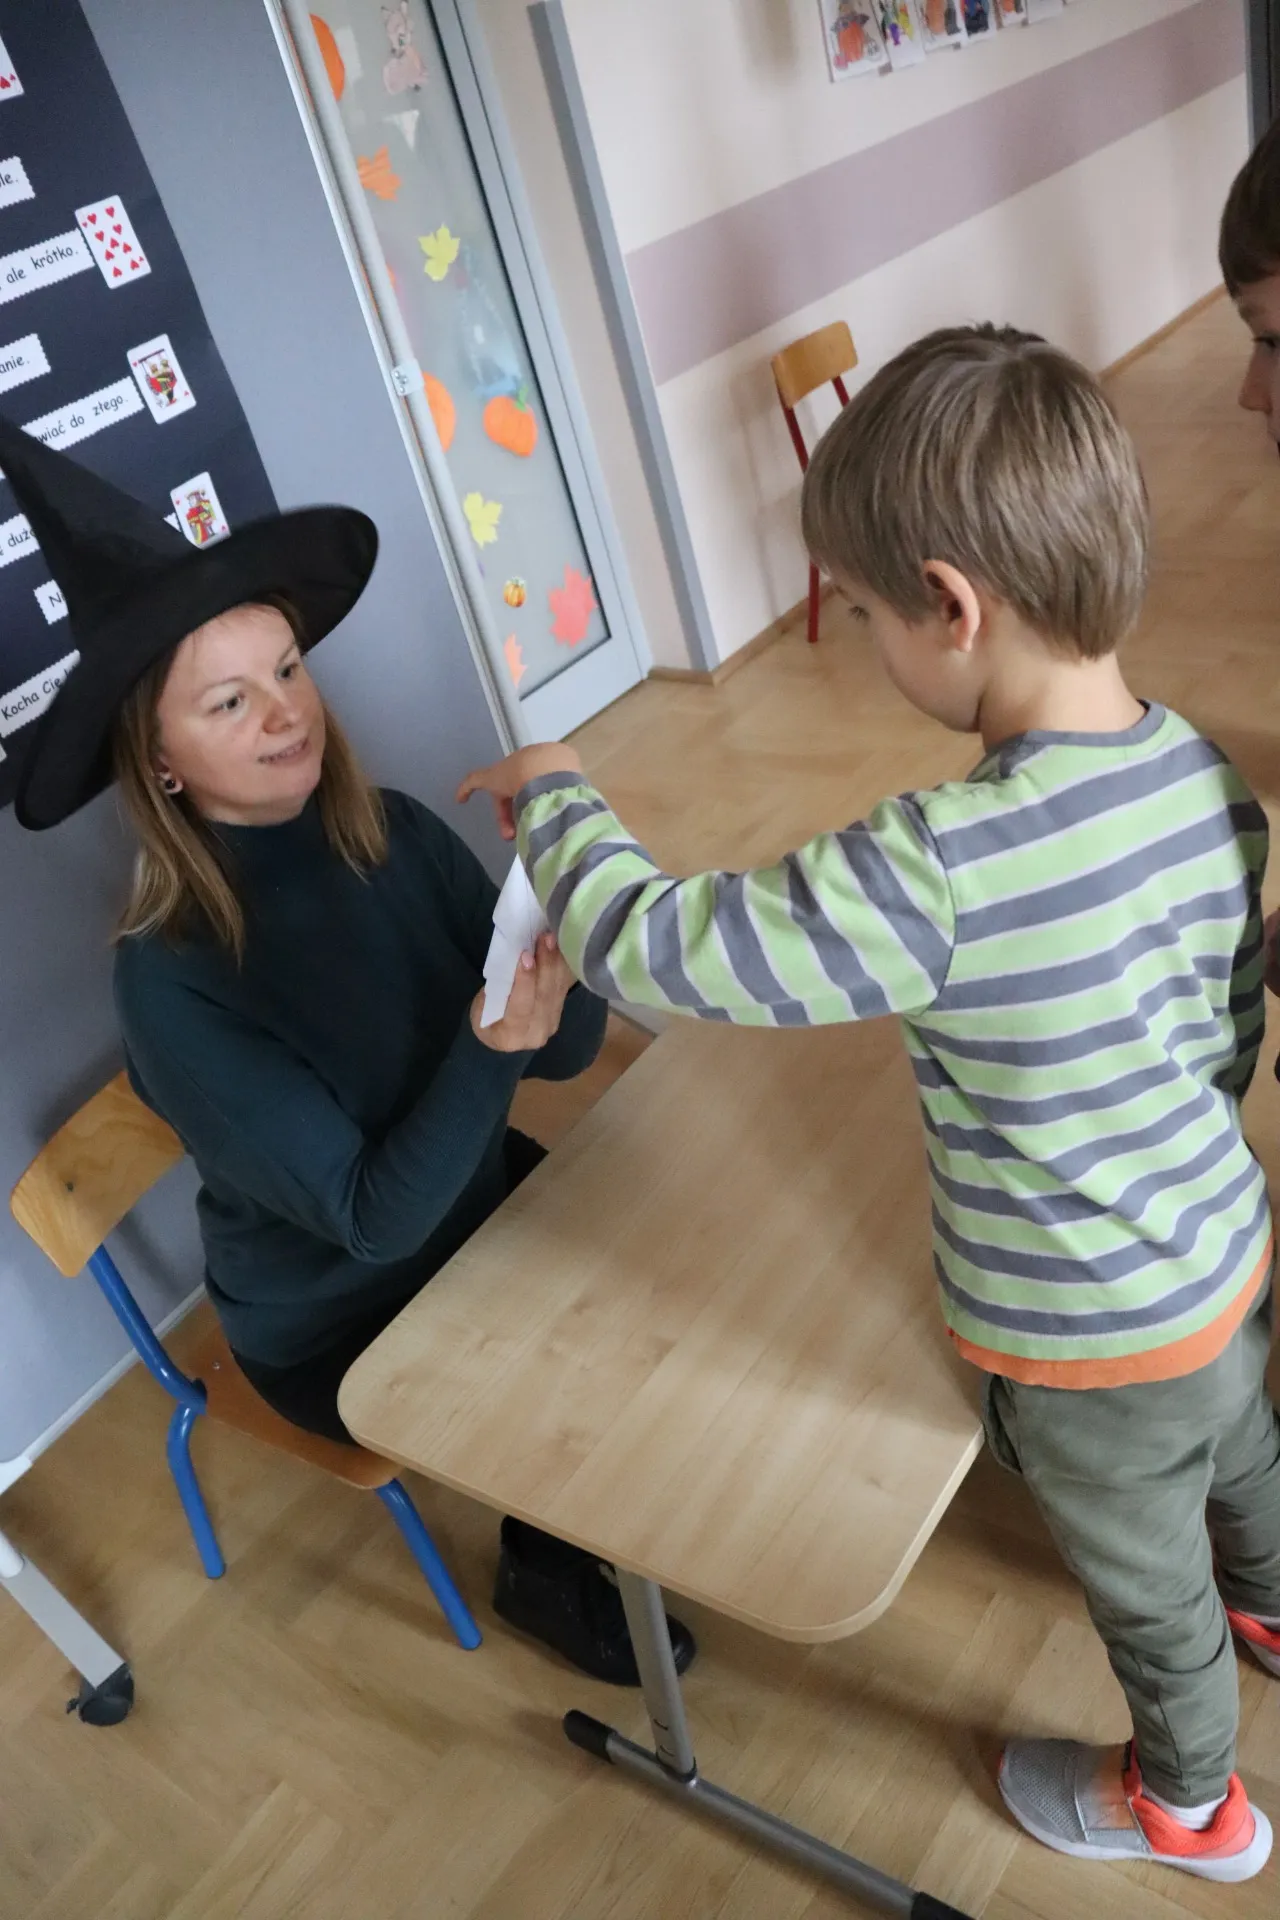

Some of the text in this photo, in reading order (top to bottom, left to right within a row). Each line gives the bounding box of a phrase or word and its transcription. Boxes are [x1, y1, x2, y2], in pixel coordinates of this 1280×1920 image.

[6, 246, 79, 284] ale krótko.
[69, 413, 85, 429] do
[92, 395, 129, 417] złego.
[1, 692, 40, 721] Kocha
